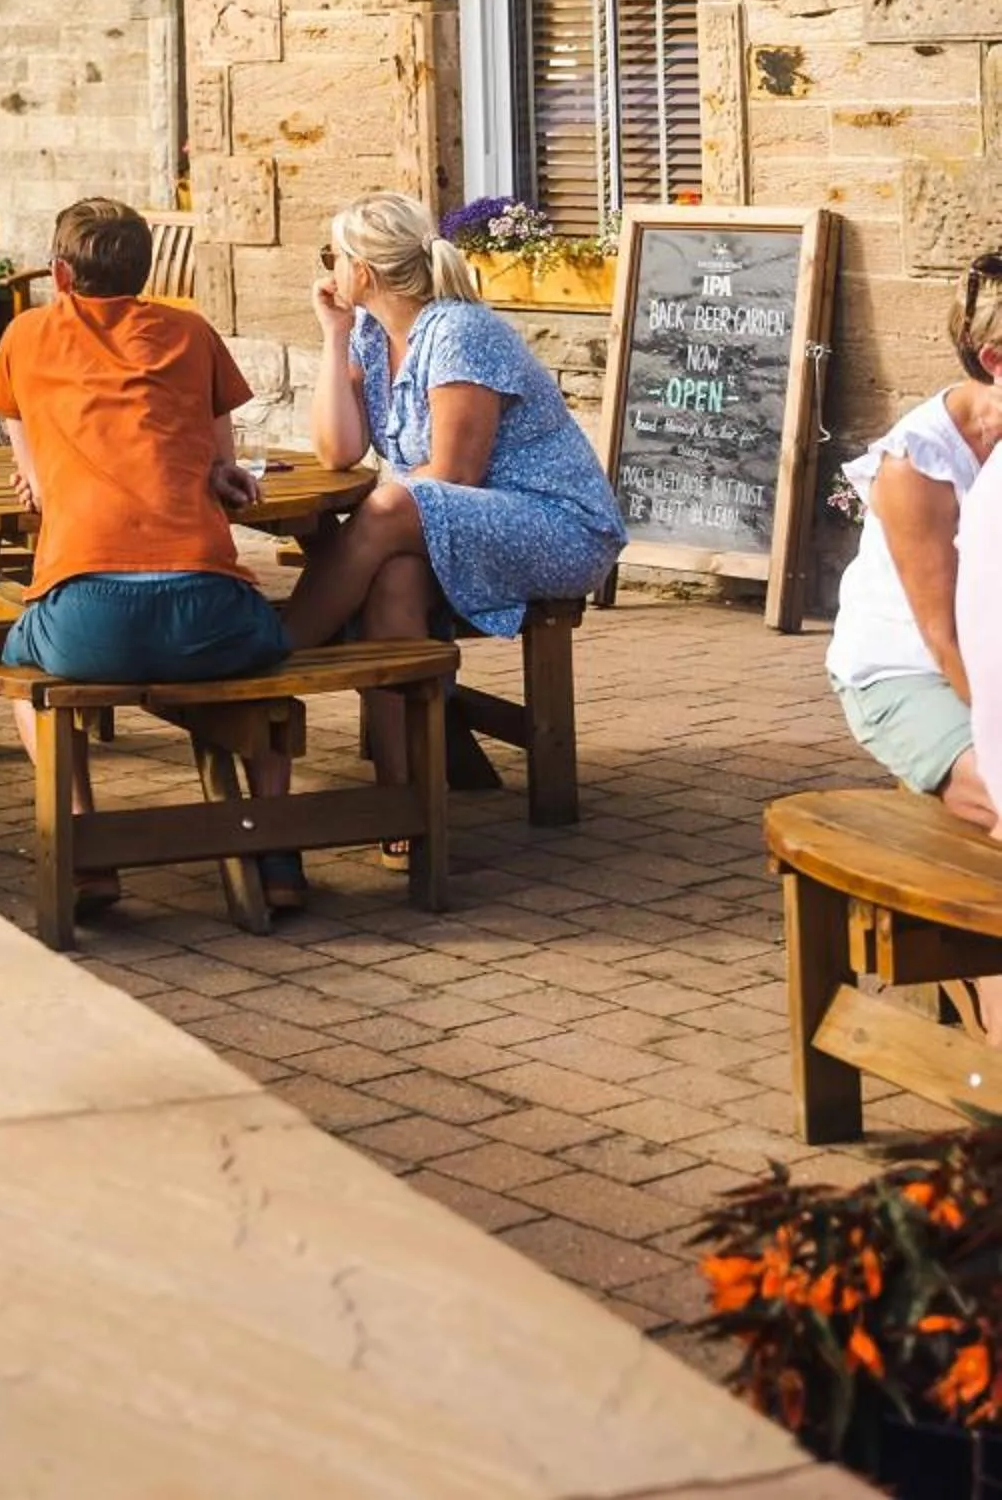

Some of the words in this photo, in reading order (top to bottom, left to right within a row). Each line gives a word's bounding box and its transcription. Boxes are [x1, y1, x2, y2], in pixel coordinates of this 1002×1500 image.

[702, 275, 732, 297] IPA
[649, 299, 687, 331] BACK
[694, 305, 731, 334] BEER
[734, 307, 785, 337] GARDEN
[687, 344, 724, 373] NOW
[666, 376, 724, 413] OPEN
